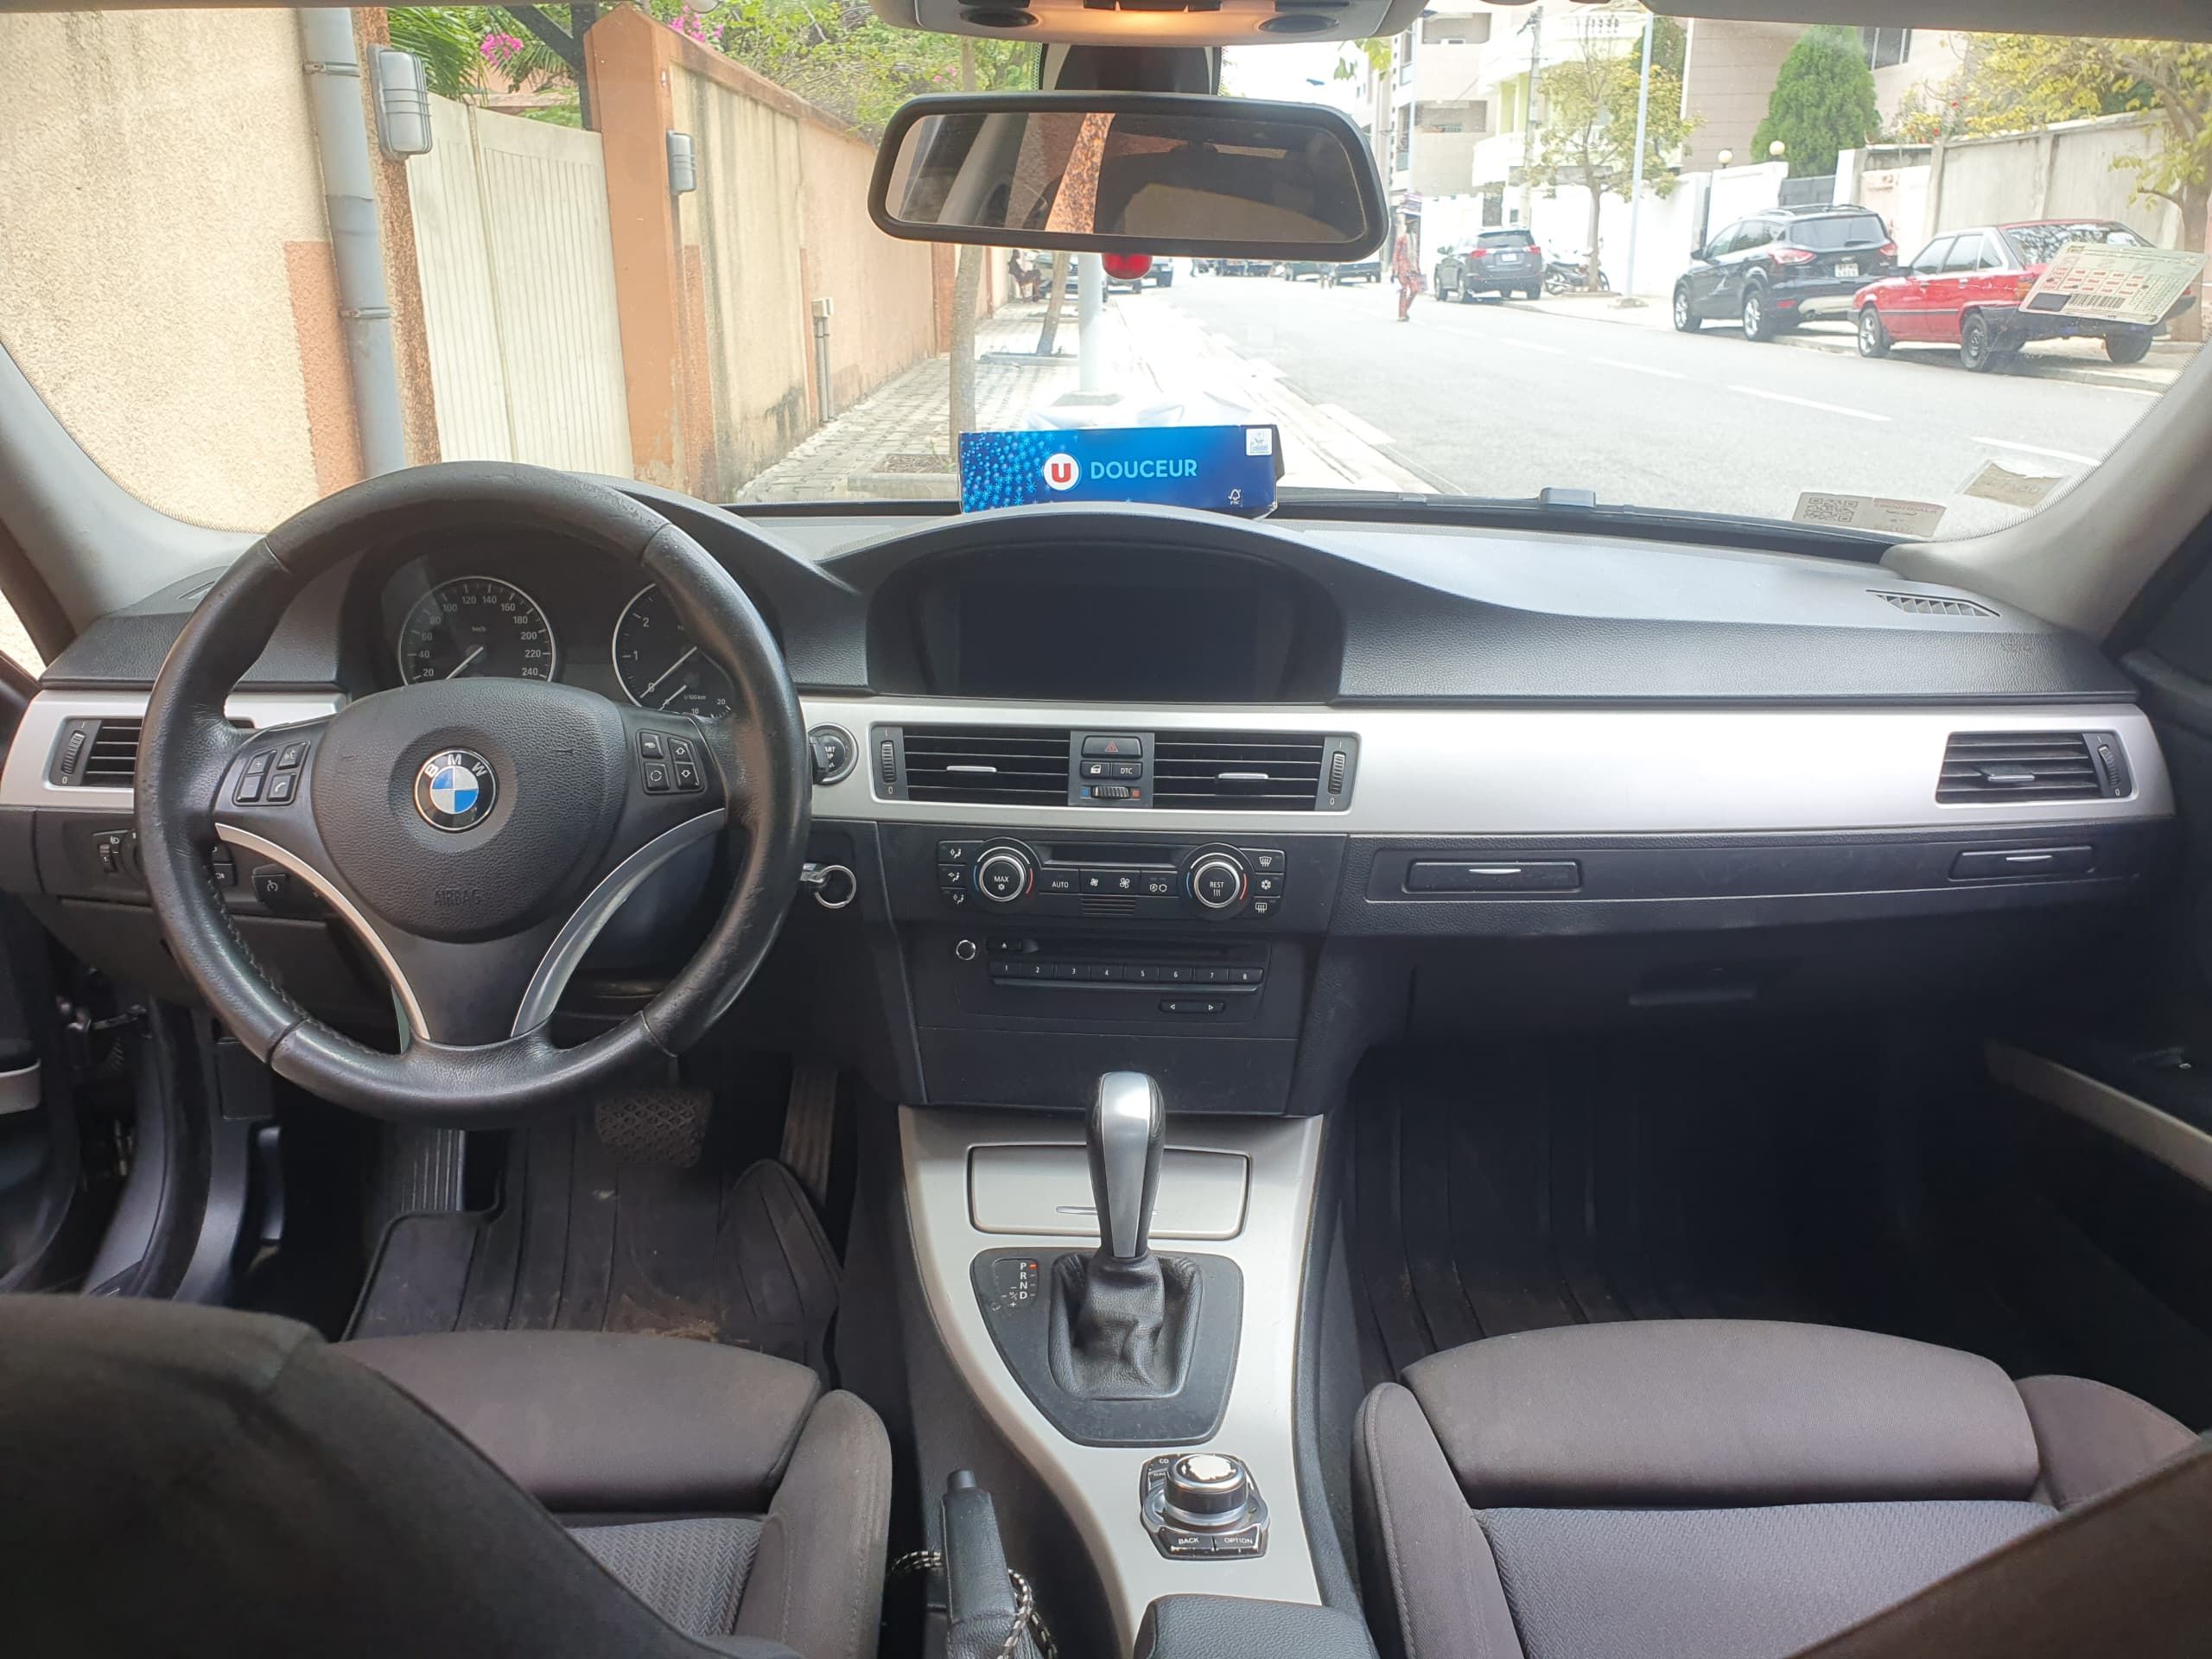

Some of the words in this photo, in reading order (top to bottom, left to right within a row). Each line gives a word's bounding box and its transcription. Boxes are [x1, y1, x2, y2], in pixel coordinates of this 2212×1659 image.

[1052, 462, 1071, 483] U
[1090, 459, 1198, 480] DOUCEUR
[501, 603, 516, 612] 160
[513, 615, 528, 624] 180
[643, 617, 650, 627] 2
[520, 632, 537, 640] 200
[633, 650, 638, 660] 1
[423, 668, 435, 677] 20
[424, 753, 487, 778] BMW
[1329, 797, 1335, 805] 0
[1020, 1291, 1028, 1300] D
